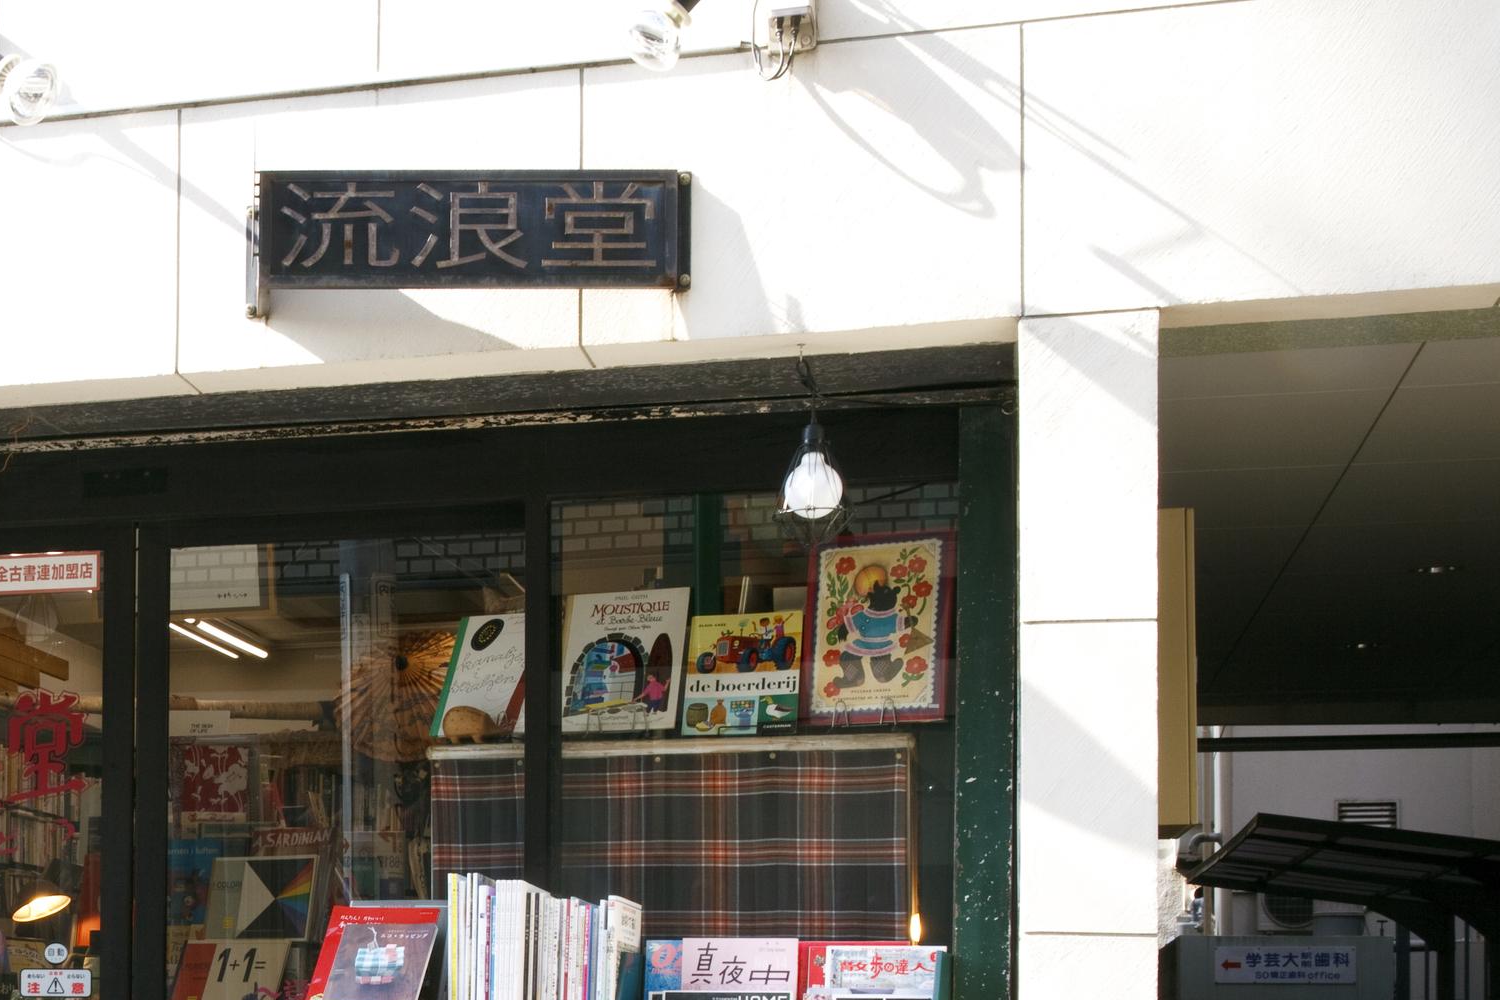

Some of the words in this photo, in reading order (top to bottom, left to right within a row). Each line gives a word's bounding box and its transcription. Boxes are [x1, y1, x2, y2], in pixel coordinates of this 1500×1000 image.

[280, 181, 657, 270] 流浪堂
[590, 600, 671, 618] MOUSTIQUE
[689, 680, 712, 693] de
[715, 676, 797, 693] boerderij
[252, 834, 266, 849] A
[48, 948, 64, 956] 自動
[689, 941, 791, 985] 真夜中
[1308, 971, 1341, 979] office
